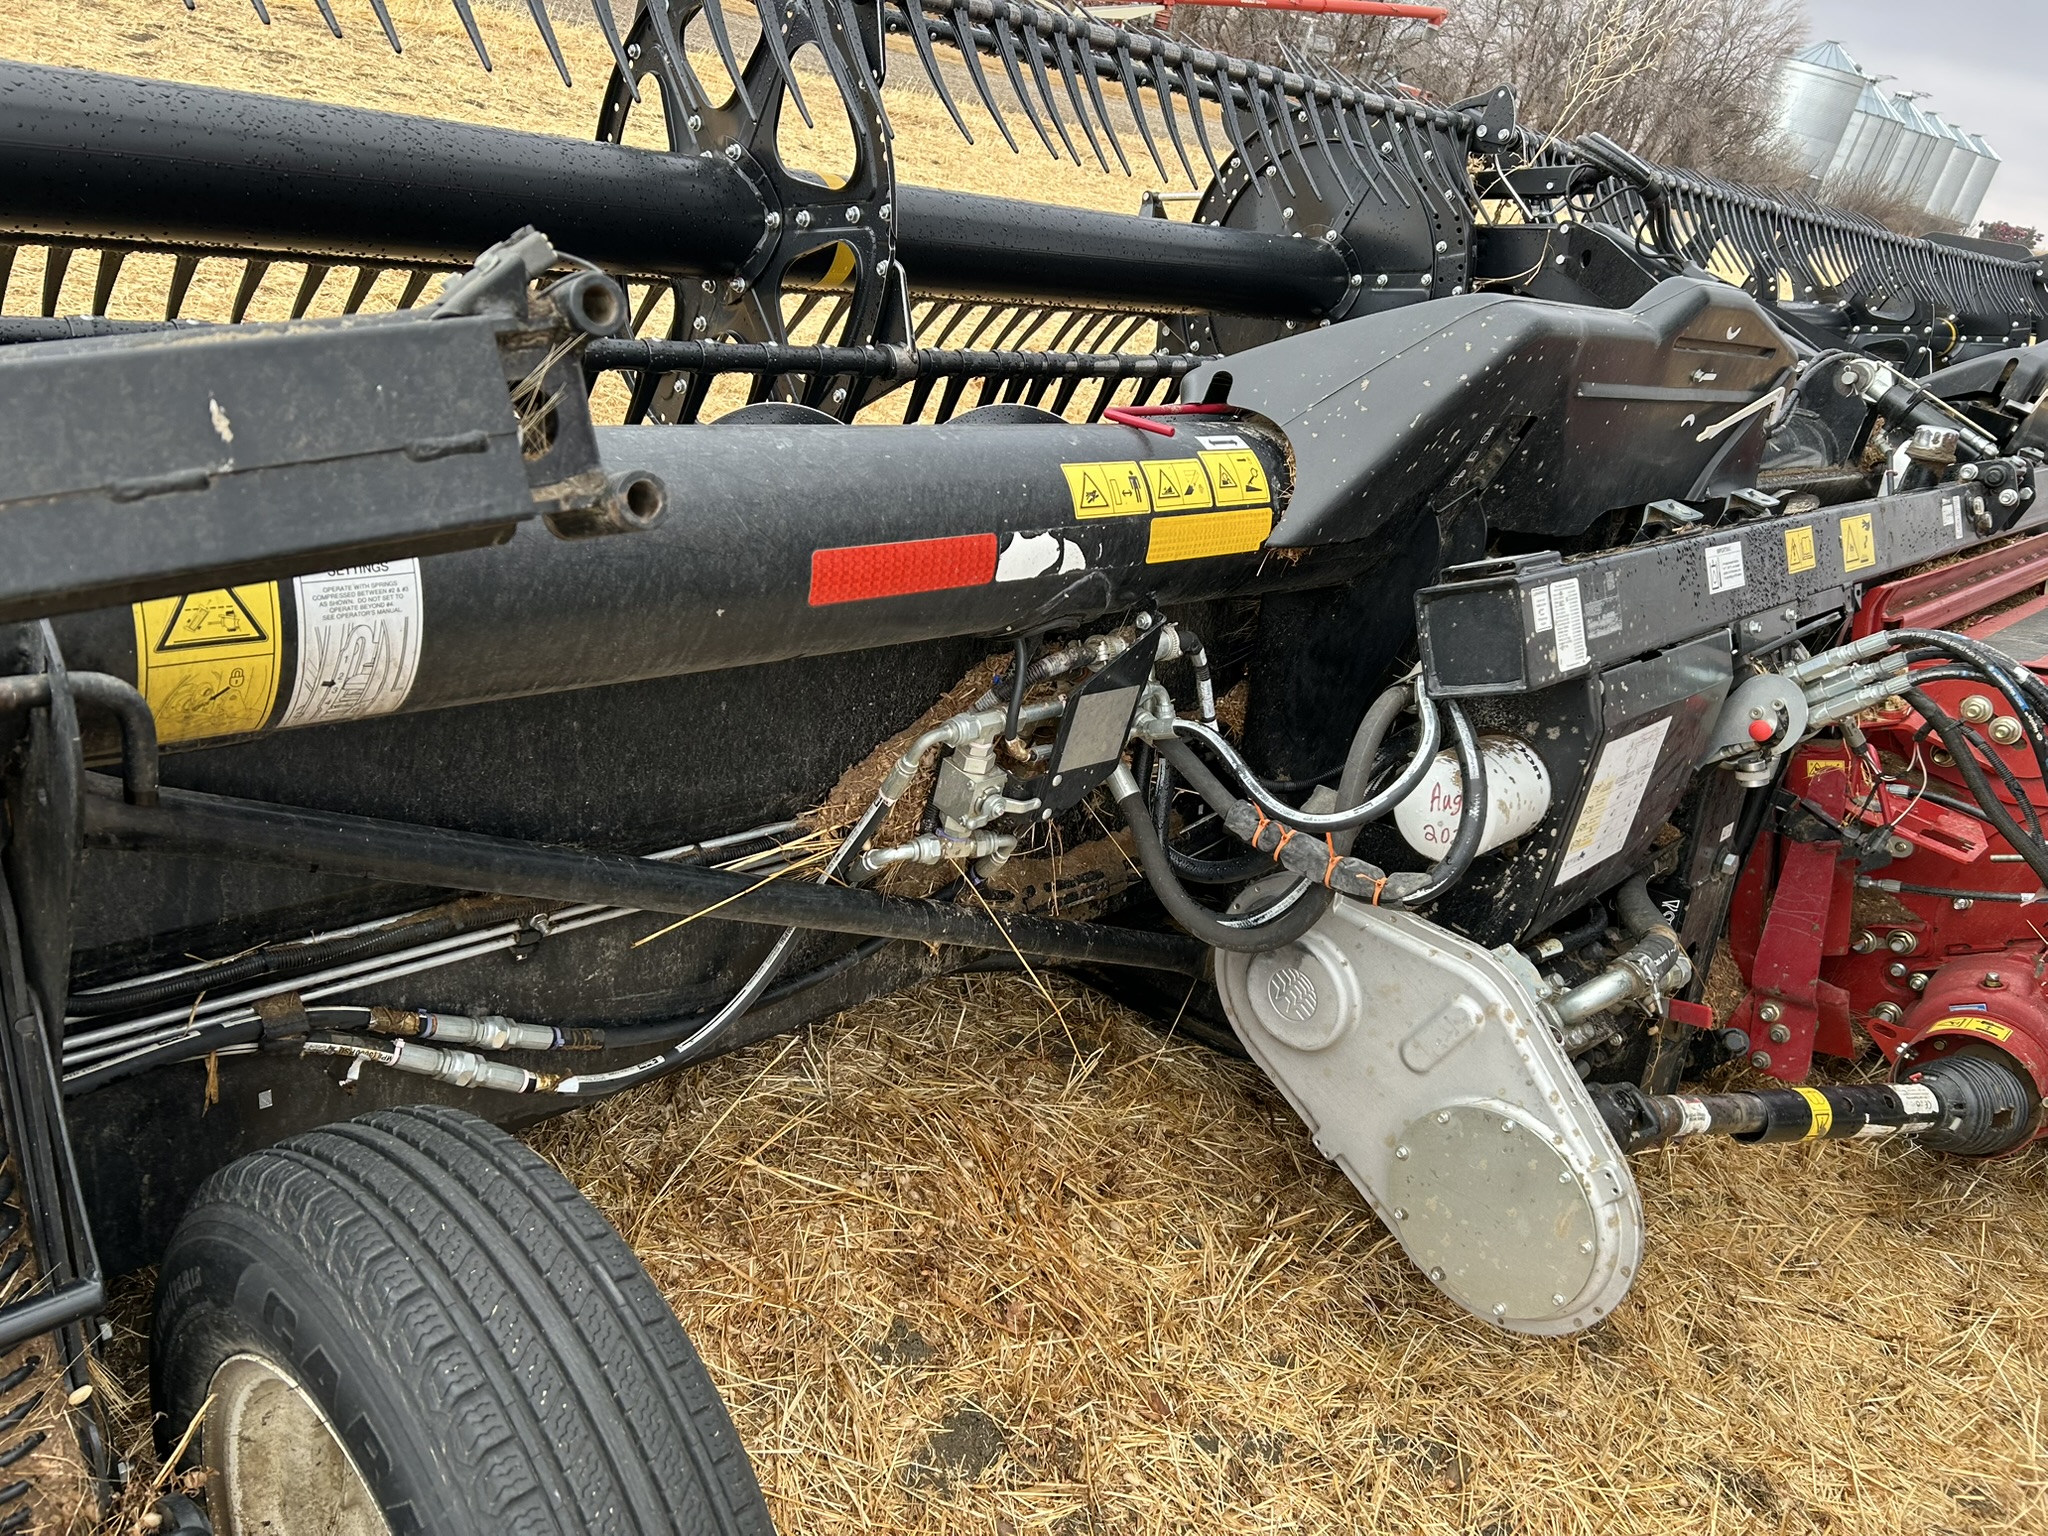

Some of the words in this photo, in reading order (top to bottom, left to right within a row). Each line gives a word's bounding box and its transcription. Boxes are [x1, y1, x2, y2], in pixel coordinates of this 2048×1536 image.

[327, 562, 389, 576] SETTINGS
[322, 584, 352, 593] OPERATE
[370, 580, 398, 589] SPRINGS
[312, 592, 356, 601] COMPRESSED
[357, 588, 388, 597] BETWEEN
[329, 604, 358, 613] OPERATE
[360, 602, 385, 611] BEYOND
[336, 610, 376, 620] OPERATOR'S
[344, 655, 348, 664] 1
[338, 672, 344, 680] 2
[1430, 781, 1463, 816] Aug
